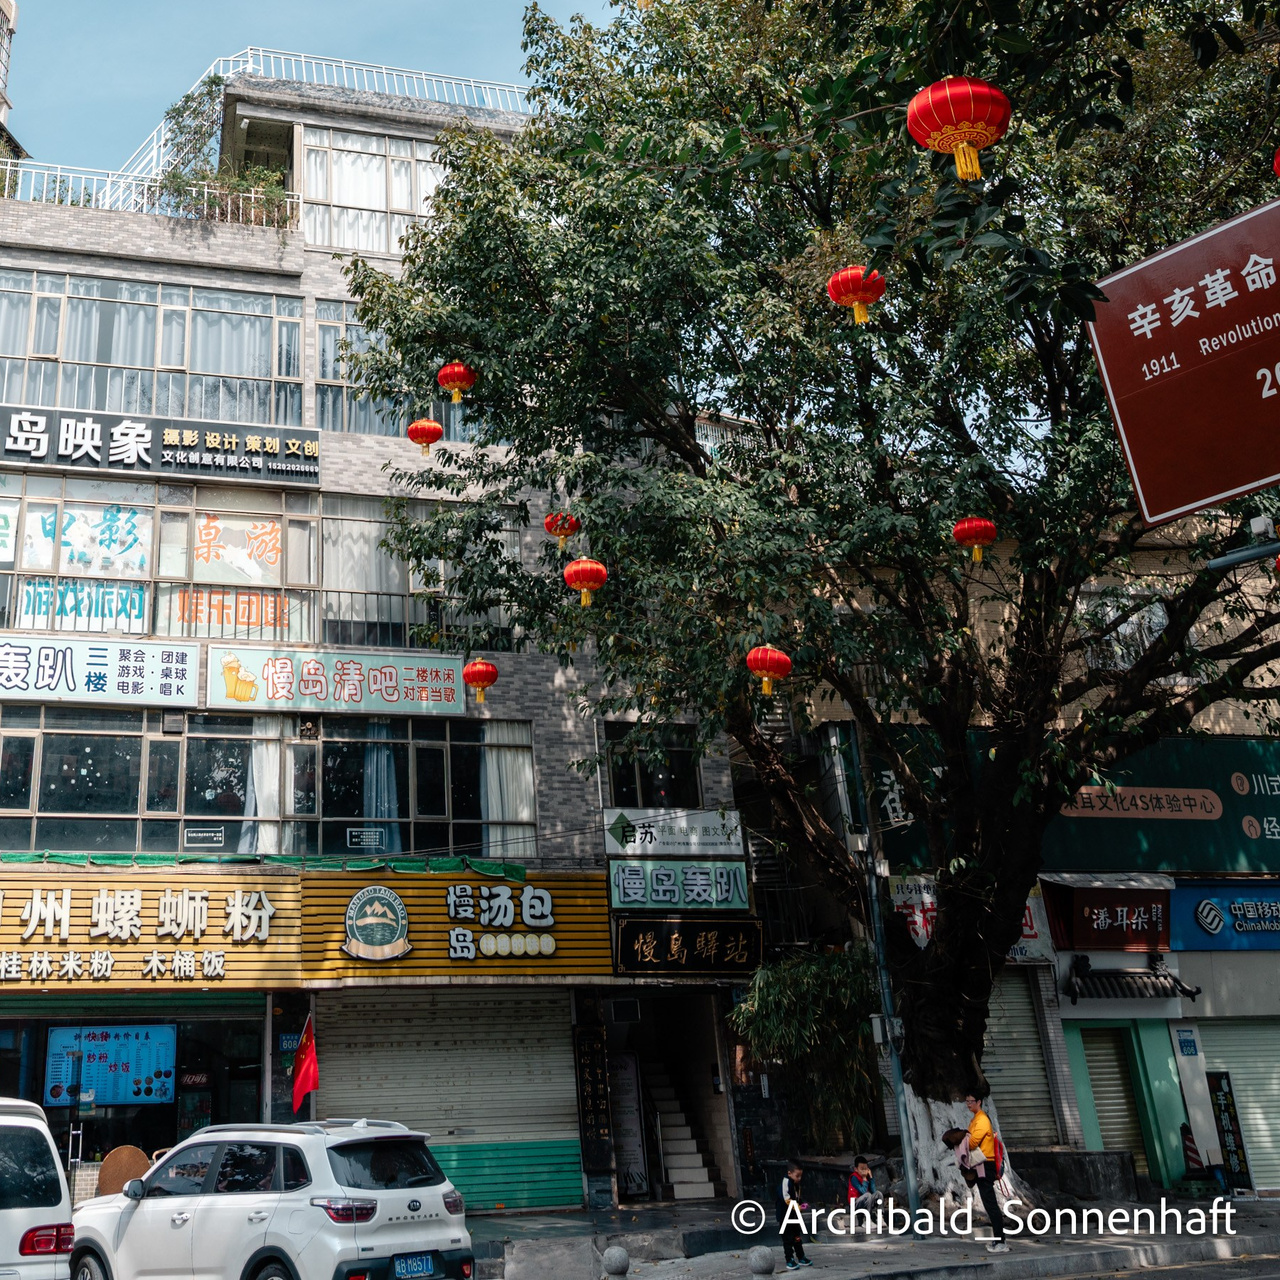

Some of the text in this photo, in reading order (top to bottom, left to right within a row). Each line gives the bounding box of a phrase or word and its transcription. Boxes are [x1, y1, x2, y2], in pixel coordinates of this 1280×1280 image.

[1127, 253, 1277, 340] 辛亥革命
[1141, 351, 1181, 381] 1911
[1256, 361, 1280, 399] 2
[161, 450, 264, 470] 文化创意有限公司
[163, 428, 320, 458] 摄影 设计 策划 文创
[40, 504, 140, 556] 电影
[193, 511, 283, 567] 桌游
[23, 579, 145, 620] 游戏派对
[176, 587, 290, 628] 娱乐团建
[84, 646, 108, 693] 三楼
[261, 657, 401, 704] 慢岛清吧
[402, 666, 456, 685] 二楼休闲
[402, 685, 457, 704] 对酒当歌
[620, 823, 657, 845] 启苏
[658, 825, 676, 836] 平面
[680, 826, 699, 837] 电商
[614, 864, 747, 904] 慢岛轰趴
[1091, 906, 1150, 932] 潘耳朵
[142, 949, 227, 979] 木桶饭
[282, 1040, 297, 1049] 608
[1217, 1091, 1242, 1173] 手机维修
